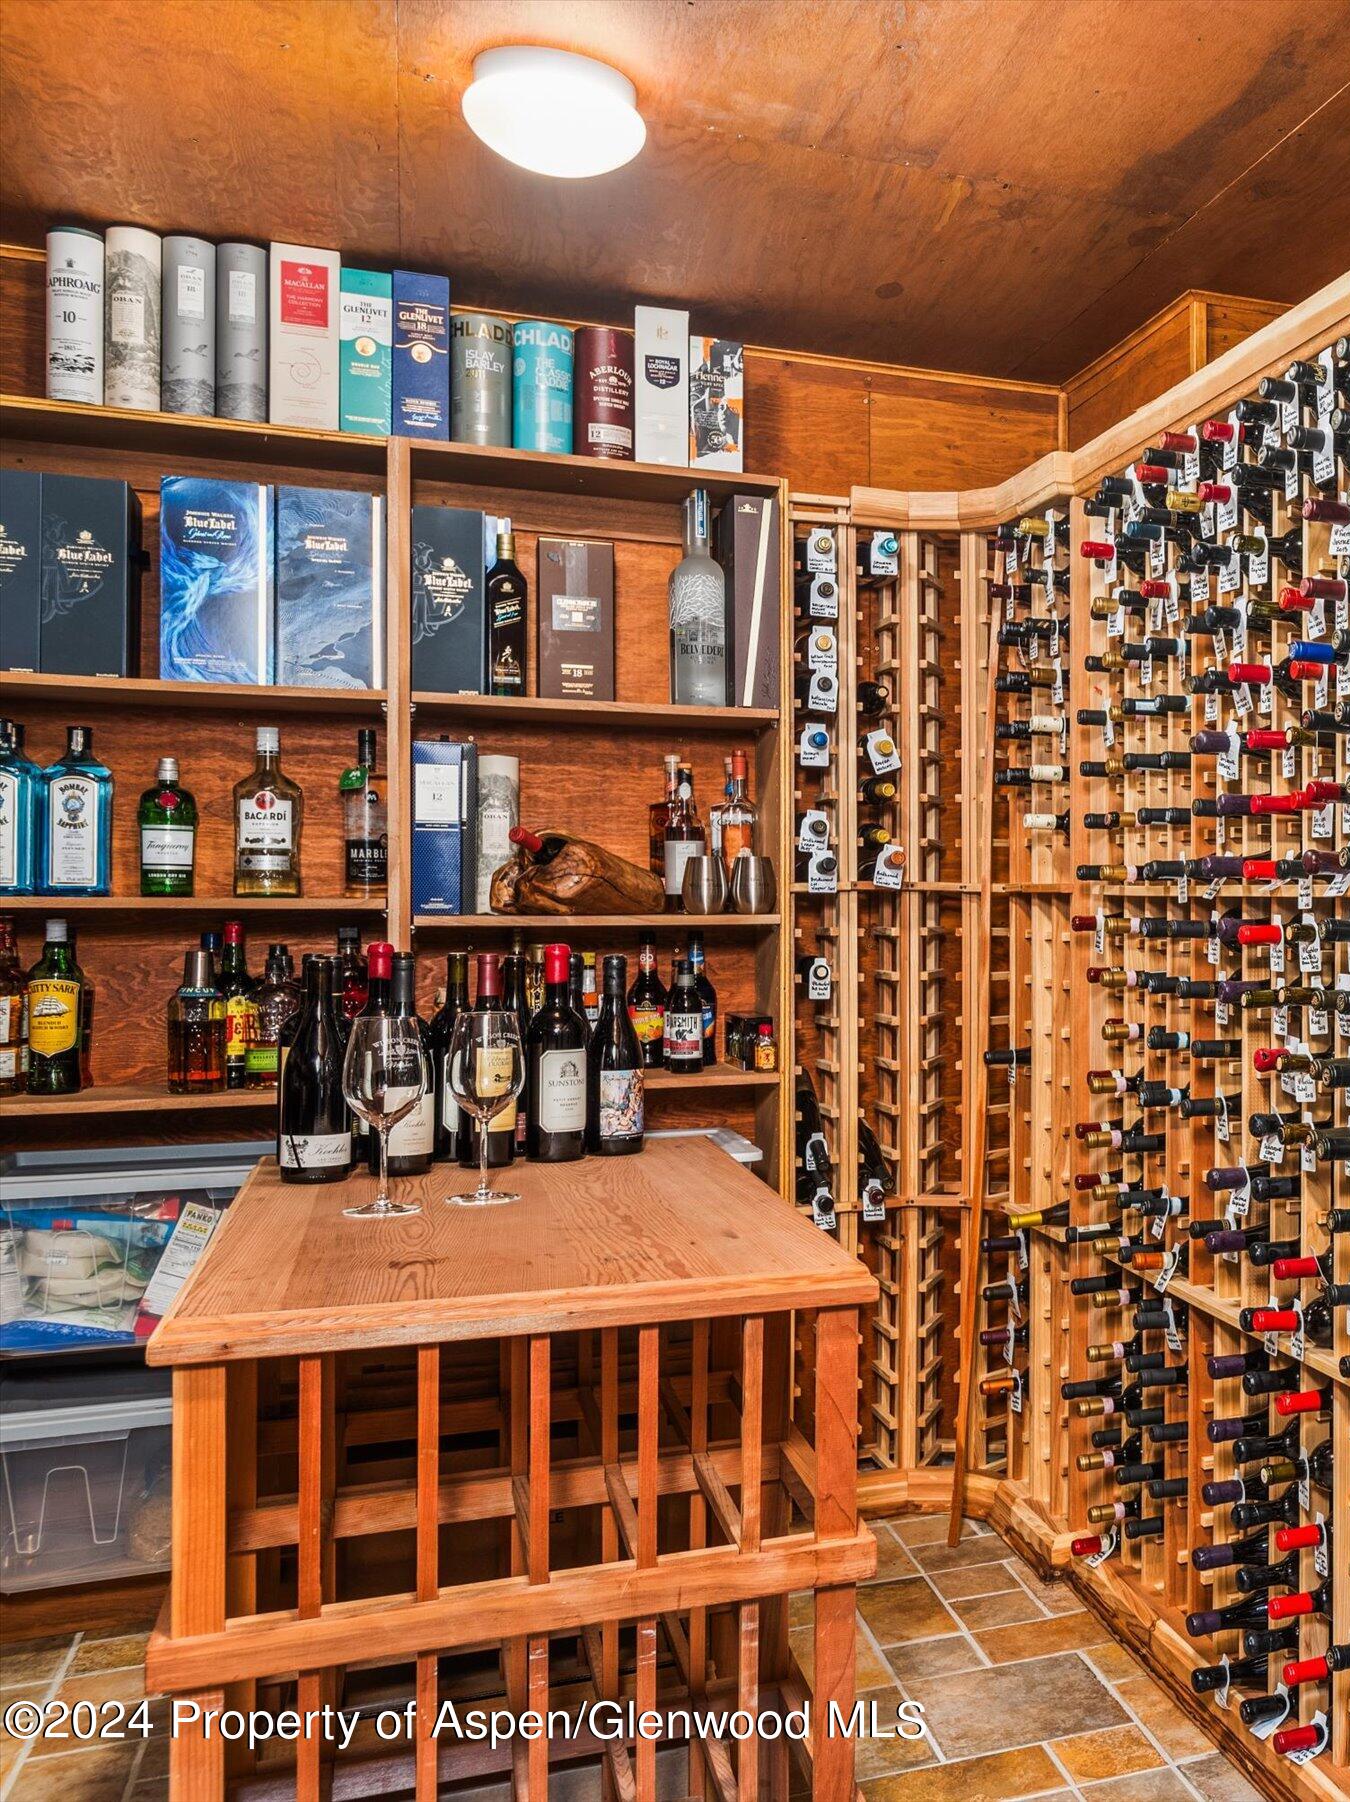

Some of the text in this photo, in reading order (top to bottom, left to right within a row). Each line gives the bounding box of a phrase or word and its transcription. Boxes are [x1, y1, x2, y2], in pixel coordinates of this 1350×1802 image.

[284, 279, 325, 290] MACALLAN
[62, 310, 76, 323] 10
[343, 305, 387, 317] GLENLIVET
[361, 315, 372, 323] 12
[399, 312, 444, 325] GLENLIVET
[416, 321, 427, 331] 18
[466, 349, 495, 361] ISLAY
[466, 359, 504, 373] BARLEY
[535, 357, 555, 368] THE
[589, 365, 632, 385] ABERLOUR
[593, 385, 629, 397] DISTILLERY
[183, 516, 208, 529] Blue
[304, 540, 325, 550] Blue
[56, 547, 82, 560] Blue
[424, 574, 446, 586] Blue
[572, 669, 583, 678] 18
[58, 783, 89, 795] BOMBAY
[432, 793, 443, 801] 12
[244, 811, 287, 821] BACARDÍ
[56, 819, 90, 829] SAPPHIRE
[146, 840, 190, 852] Tanqueray
[52, 983, 76, 994] SARK
[187, 1210, 213, 1223] PANKO
